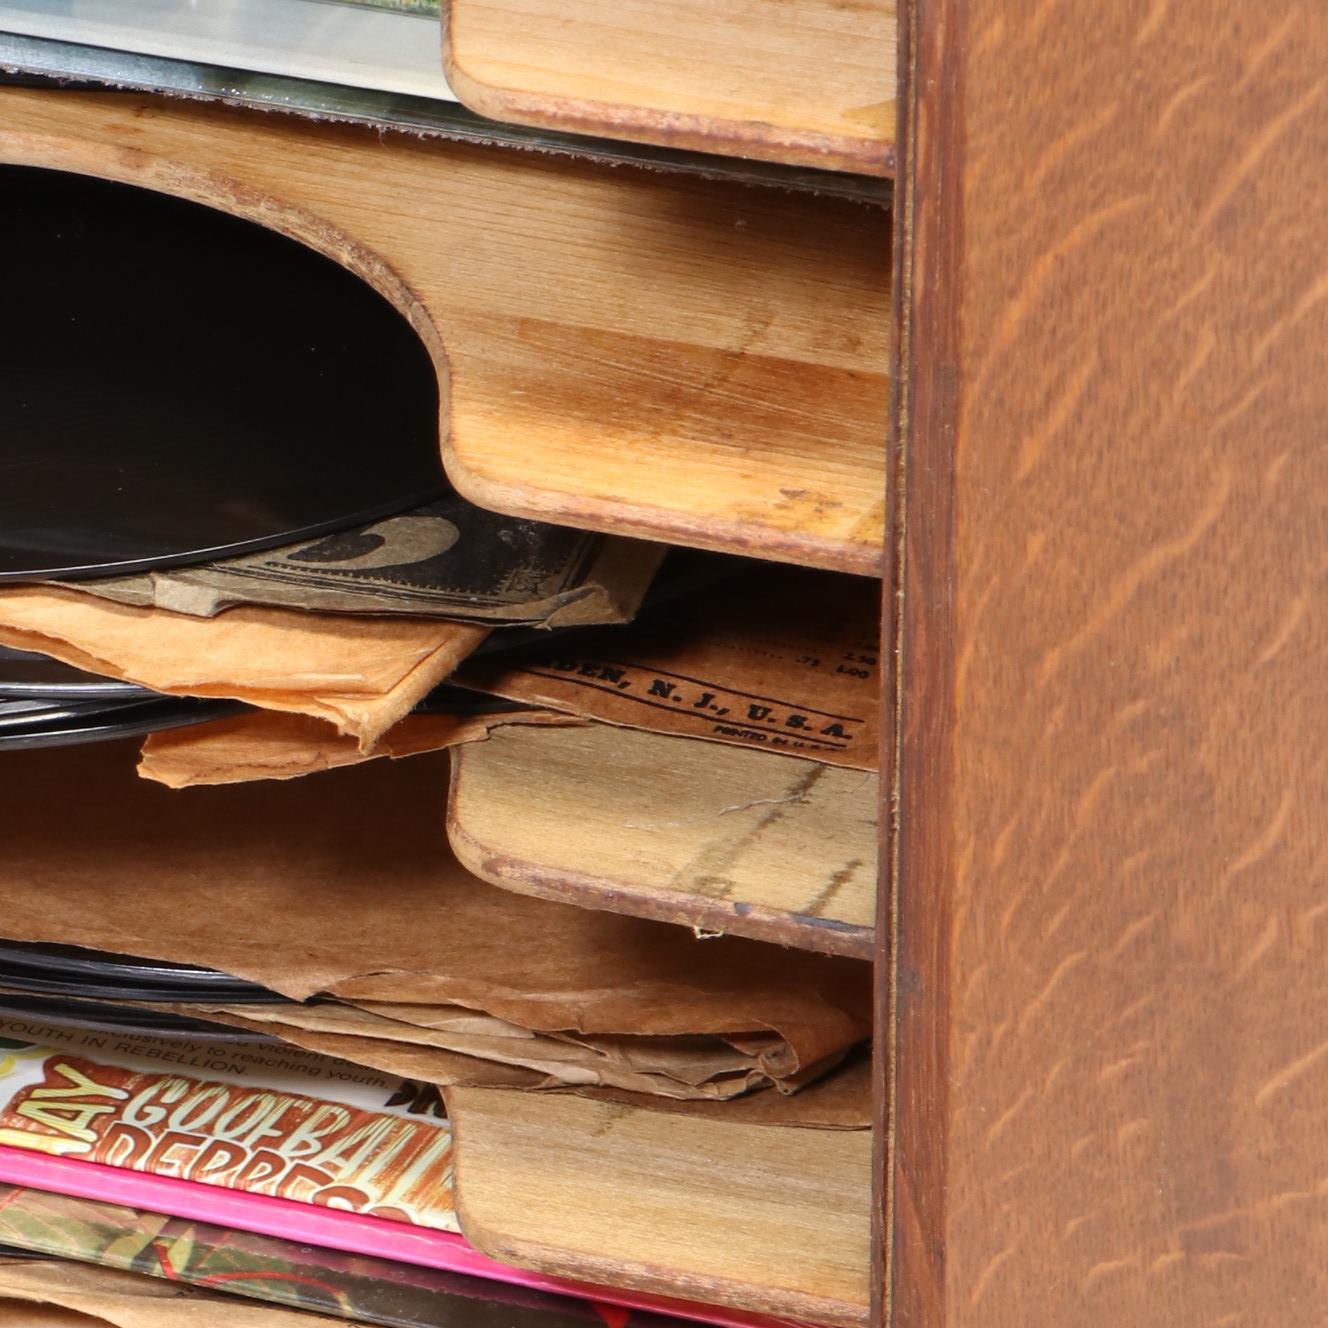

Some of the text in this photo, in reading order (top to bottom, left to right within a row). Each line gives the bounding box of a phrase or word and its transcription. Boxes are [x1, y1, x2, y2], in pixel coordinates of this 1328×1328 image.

[80, 1035, 108, 1048] IN
[113, 1042, 249, 1075] REBELLION.
[231, 1052, 320, 1077] reaching
[323, 1069, 390, 1090] youth.
